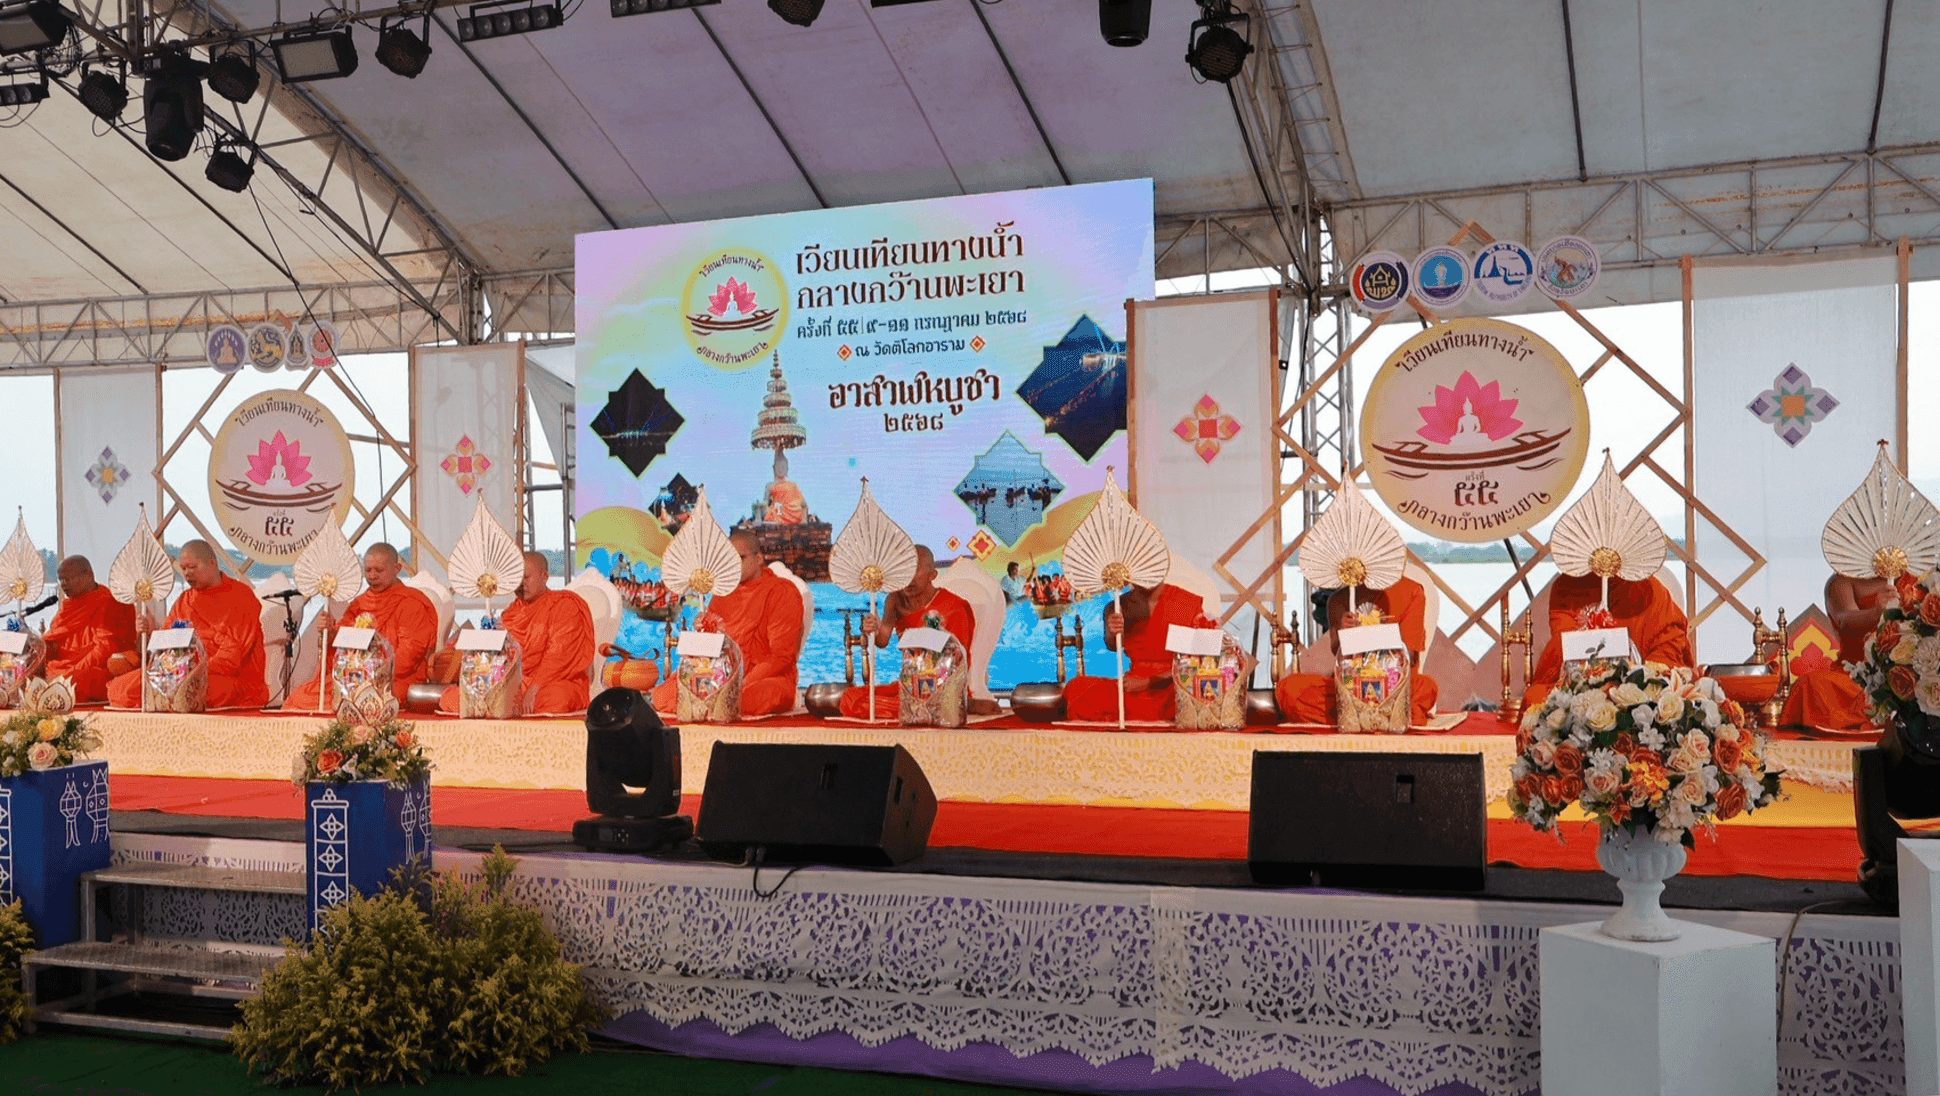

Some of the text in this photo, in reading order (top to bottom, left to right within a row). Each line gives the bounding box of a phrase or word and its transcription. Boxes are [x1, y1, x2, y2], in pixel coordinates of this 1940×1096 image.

[796, 220, 1024, 275] เวียนเทียนทางน้ำ
[698, 254, 765, 277] เวียนเทียนทางน้ำ
[796, 270, 1025, 310] กลางกว๊านพะเยา
[797, 315, 832, 339] ครั้งที่
[837, 317, 858, 336] ๕๕
[914, 312, 980, 333] กรกฎาคม
[985, 309, 1027, 326] ๒๕๖๘
[855, 338, 965, 357] ณ วัดติโลกอาราม
[1394, 329, 1535, 373] เวียนเทียนทางน้ำ
[828, 368, 1001, 416] อาสาฬหบูชา
[234, 397, 324, 428] เวียนเทียนทางน้ำ
[884, 412, 944, 433] ๒๕๖๘
[1454, 480, 1499, 507] ๕๕
[1397, 489, 1551, 531] กลางกว๊านพะเยา
[265, 516, 294, 537] ๕๕
